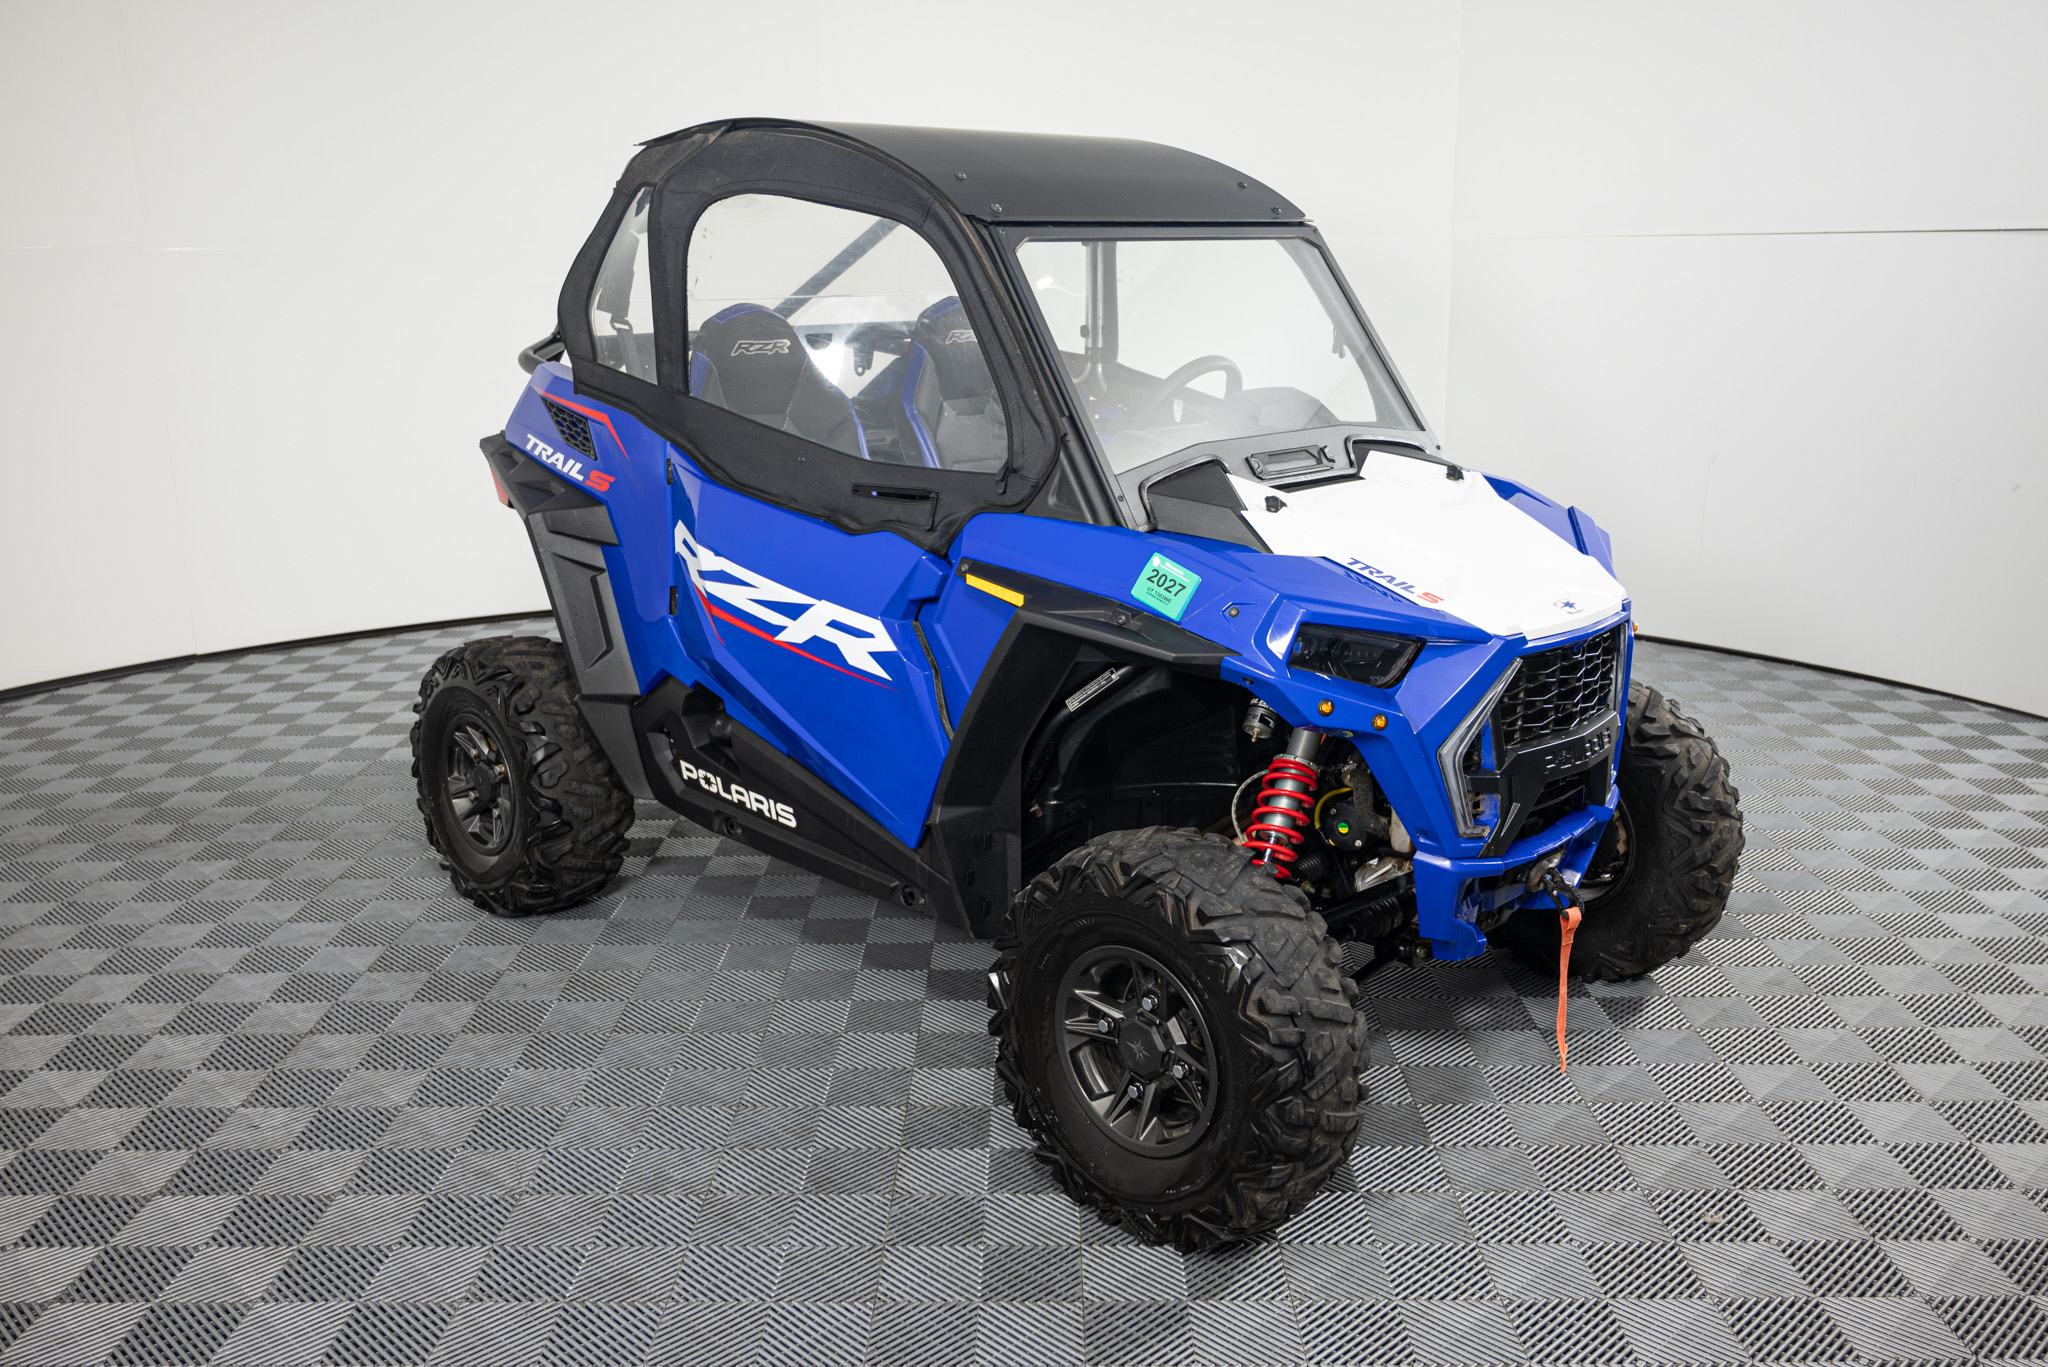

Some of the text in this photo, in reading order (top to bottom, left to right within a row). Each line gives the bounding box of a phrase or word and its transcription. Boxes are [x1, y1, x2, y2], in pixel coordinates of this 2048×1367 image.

[731, 339, 790, 356] RZR
[526, 433, 615, 492] TRAIL S
[674, 519, 898, 682] RZR
[1146, 568, 1187, 597] 2027
[1346, 557, 1444, 604] TRAIL S
[680, 759, 797, 829] POLARIS
